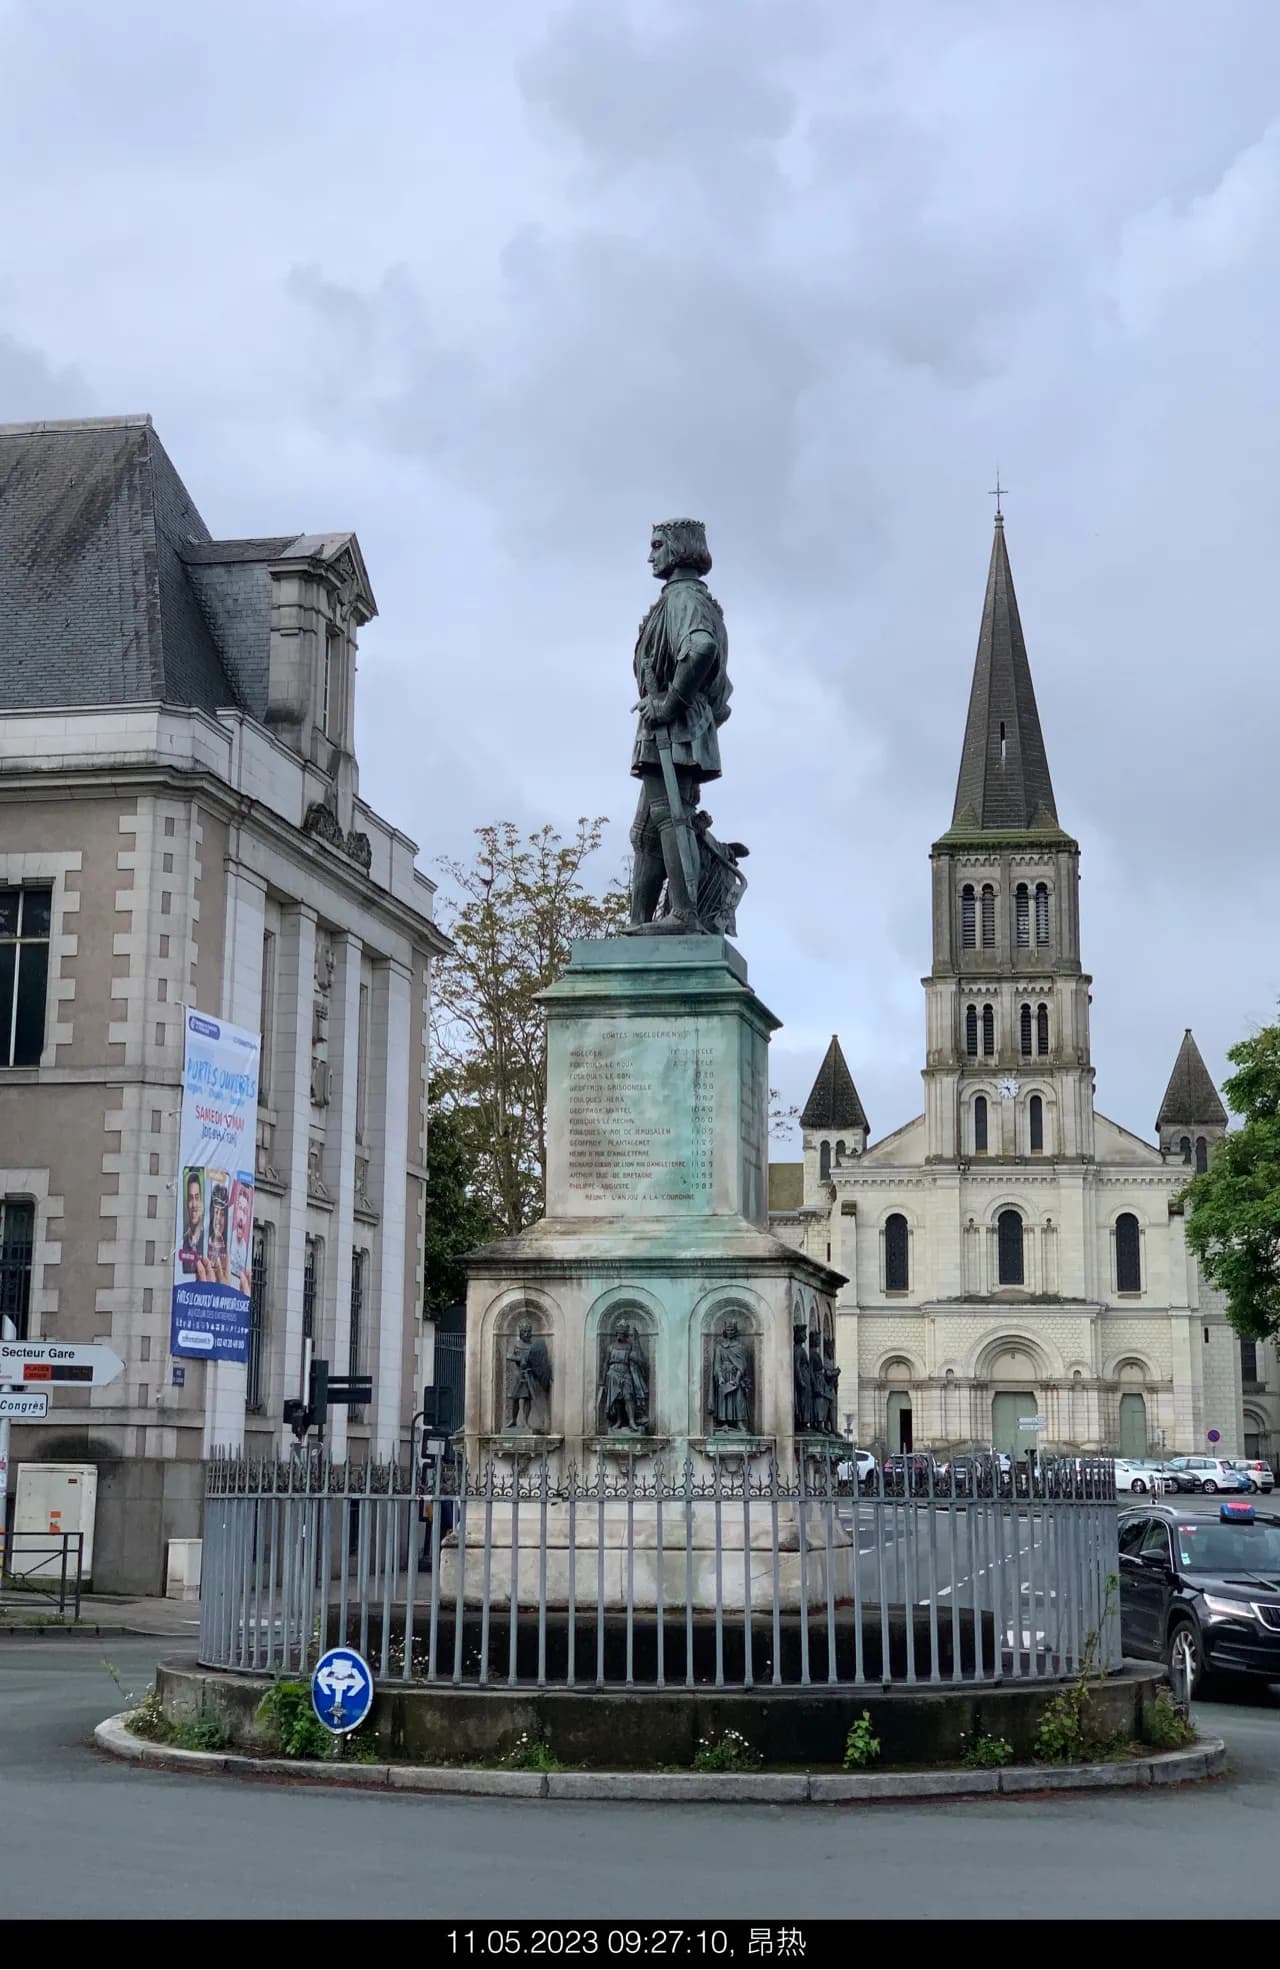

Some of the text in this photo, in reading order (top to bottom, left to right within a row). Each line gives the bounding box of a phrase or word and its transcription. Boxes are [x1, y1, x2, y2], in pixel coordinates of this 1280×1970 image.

[187, 1057, 218, 1087] PORTES
[220, 1070, 256, 1098] OUVERTES
[195, 1104, 222, 1127] SAMEDI
[635, 1128, 671, 1136] JERUSALEM
[1, 1346, 75, 1359] Secteur Gare
[0, 1399, 45, 1413] Congrès
